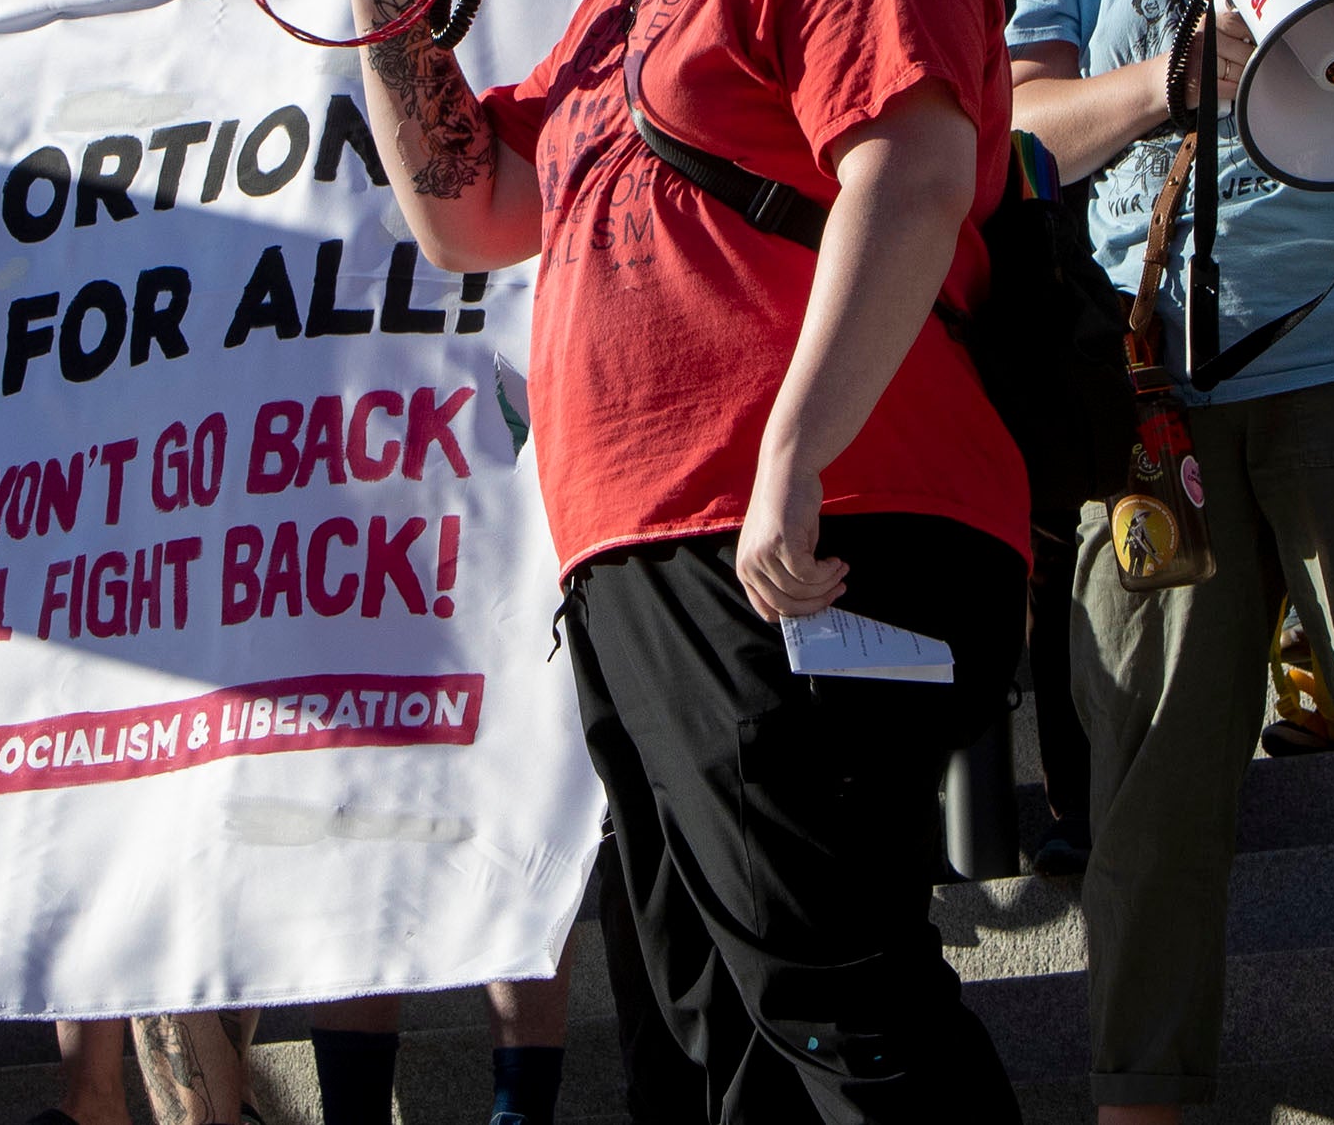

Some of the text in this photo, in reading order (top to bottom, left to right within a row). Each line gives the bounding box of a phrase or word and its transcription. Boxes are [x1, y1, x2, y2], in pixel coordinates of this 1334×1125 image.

[2, 265, 190, 396] FOR
[224, 239, 490, 349] ALL!
[151, 412, 228, 512] GO
[246, 386, 477, 494] BACK
[38, 536, 203, 640] FIGHT
[219, 515, 462, 627] BACK!
[187, 717, 208, 751] &
[220, 689, 471, 745] LIBERATION
